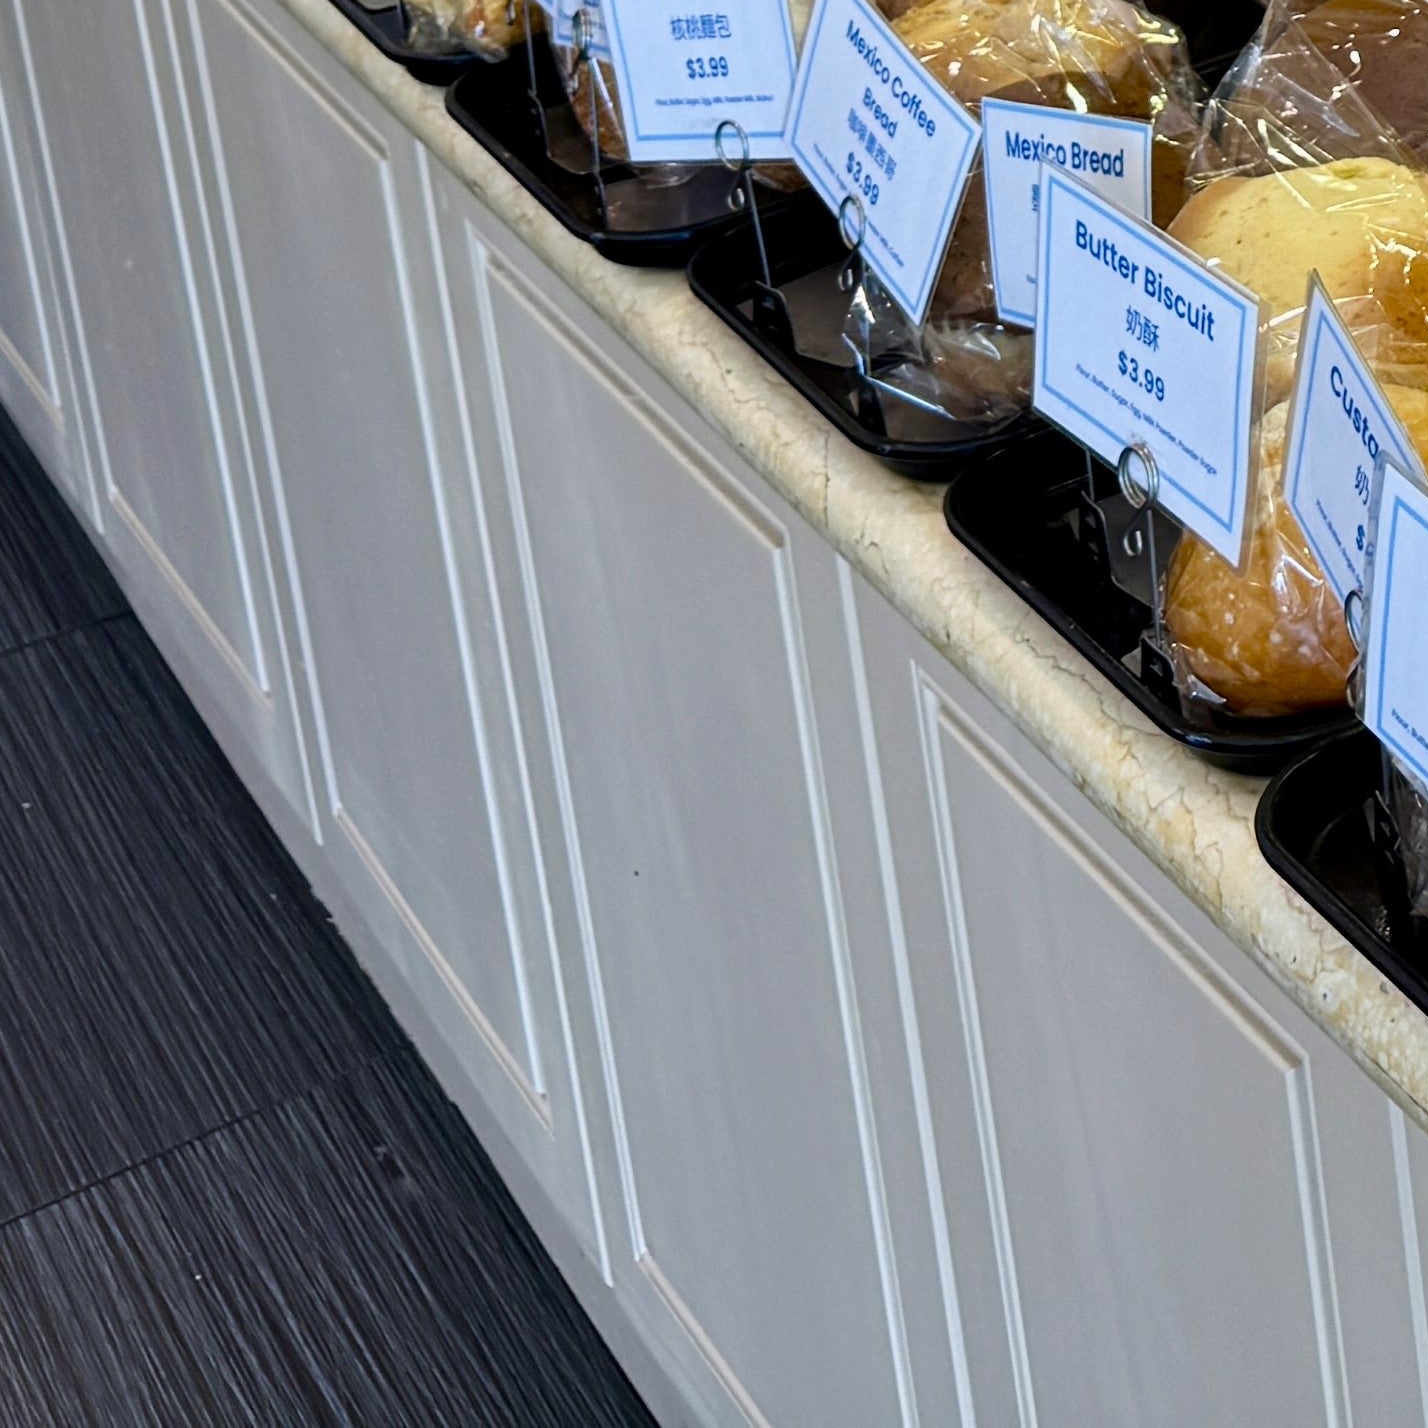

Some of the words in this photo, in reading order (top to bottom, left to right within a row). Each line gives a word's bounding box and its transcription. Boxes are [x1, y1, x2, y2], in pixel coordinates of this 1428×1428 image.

[686, 55, 730, 80] $3.99
[845, 20, 892, 87] Mexico
[891, 76, 937, 139] Coffee
[862, 86, 898, 139] Bread
[845, 152, 881, 207] $3.99
[1005, 129, 1067, 166] Mexico
[1069, 142, 1125, 179] Bread
[1074, 218, 1140, 285] Butter
[1143, 264, 1217, 343] Biscuit
[1125, 303, 1161, 354] 奶酥
[1117, 350, 1166, 403] $3.99
[1328, 364, 1381, 462] Custa
